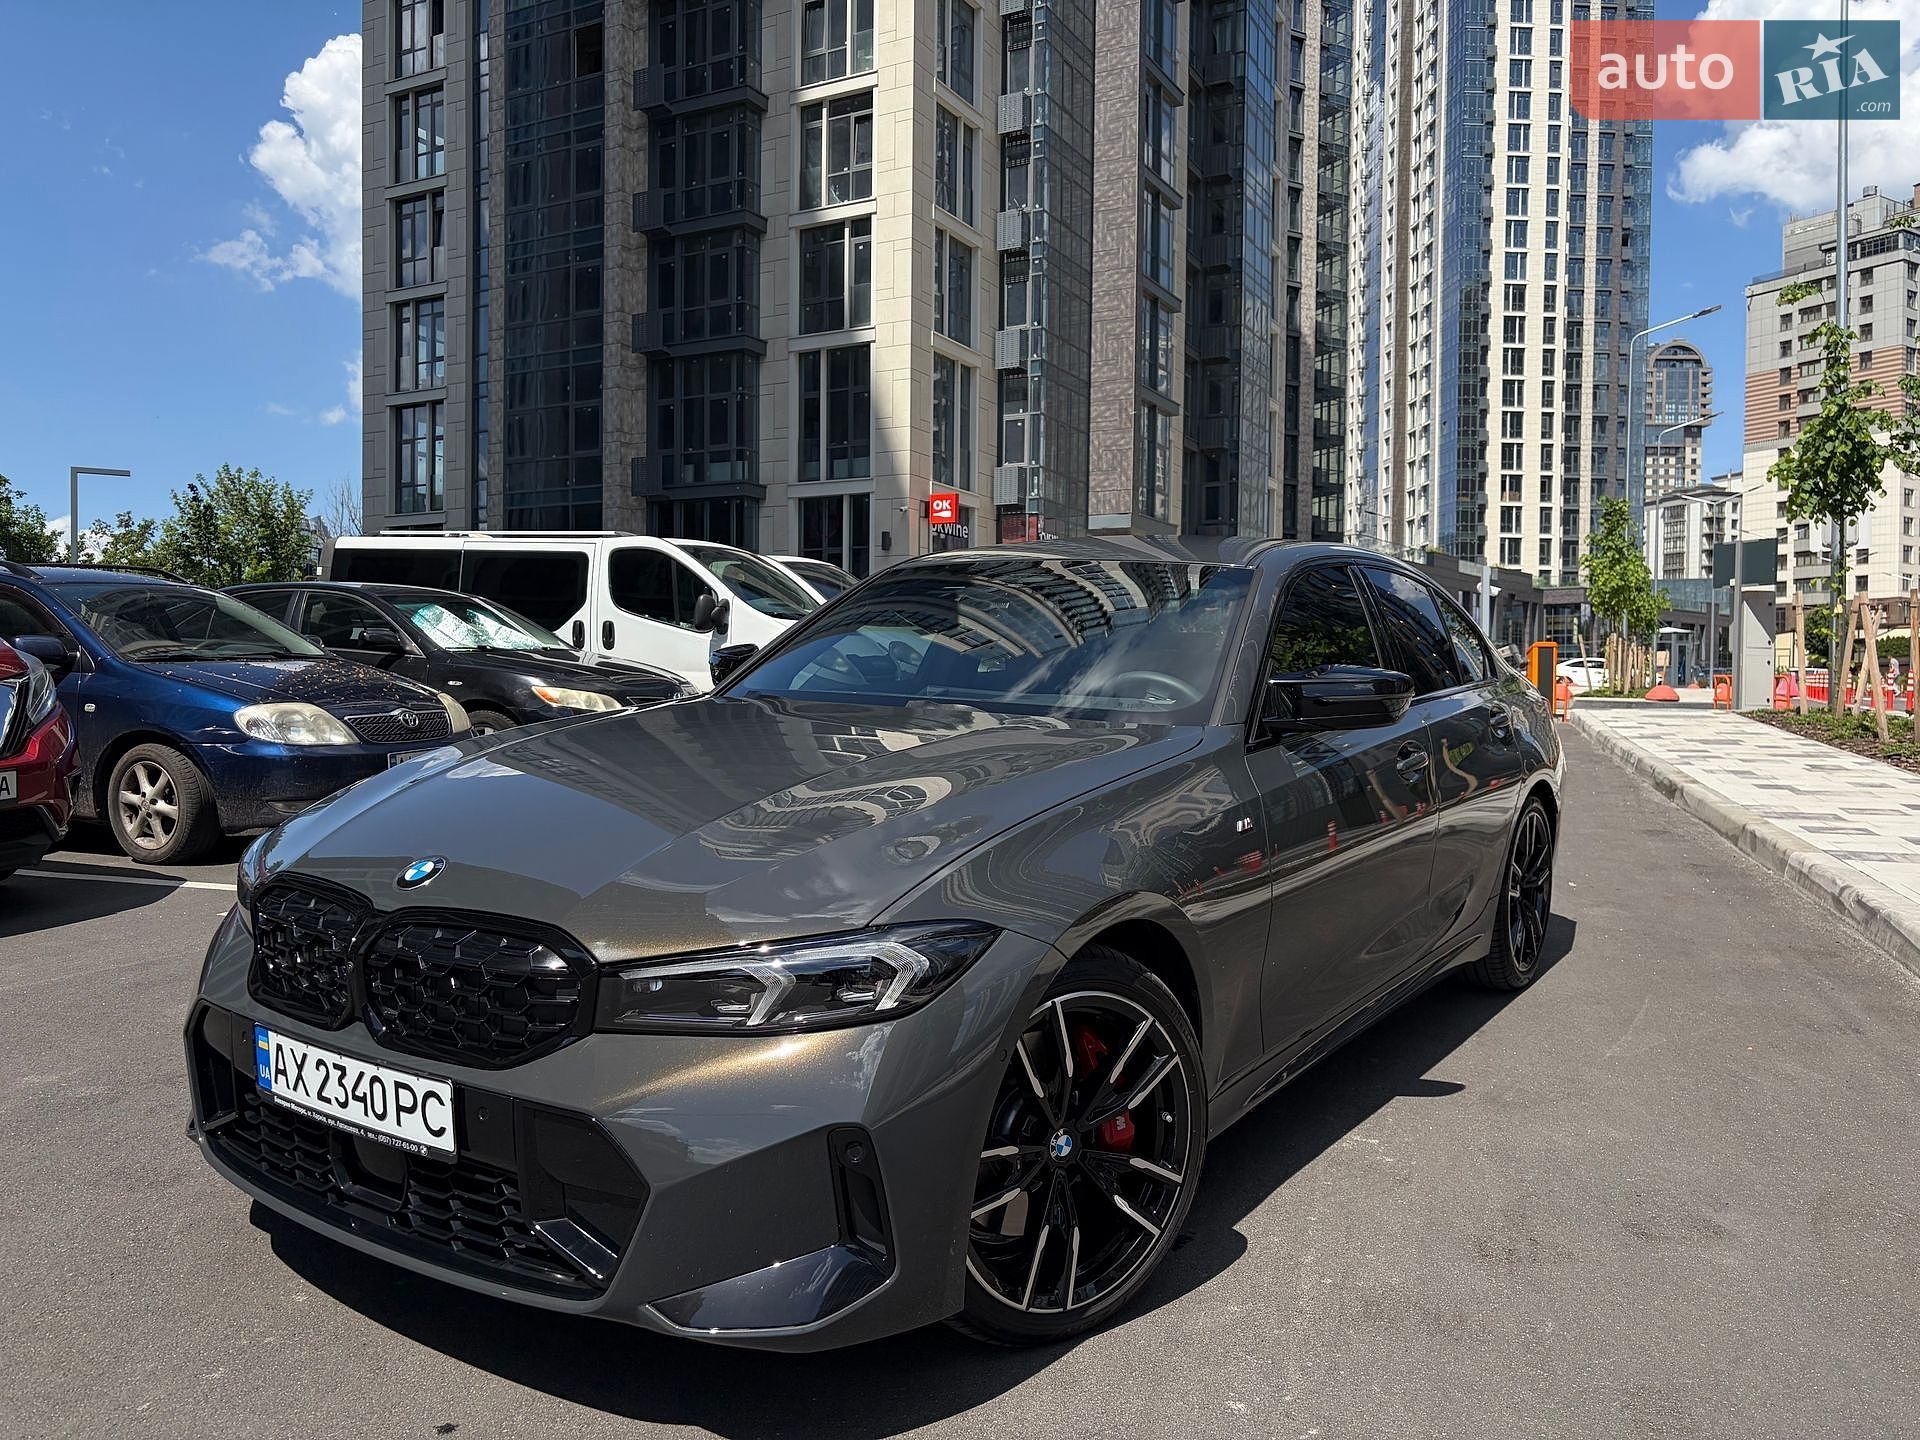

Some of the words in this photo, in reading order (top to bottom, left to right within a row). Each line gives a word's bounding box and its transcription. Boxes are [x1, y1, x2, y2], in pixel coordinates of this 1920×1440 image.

[933, 499, 951, 510] OK
[259, 1063, 271, 1080] UA
[274, 1043, 311, 1097] AX
[315, 1058, 388, 1121] 2340
[393, 1080, 447, 1138] PC
